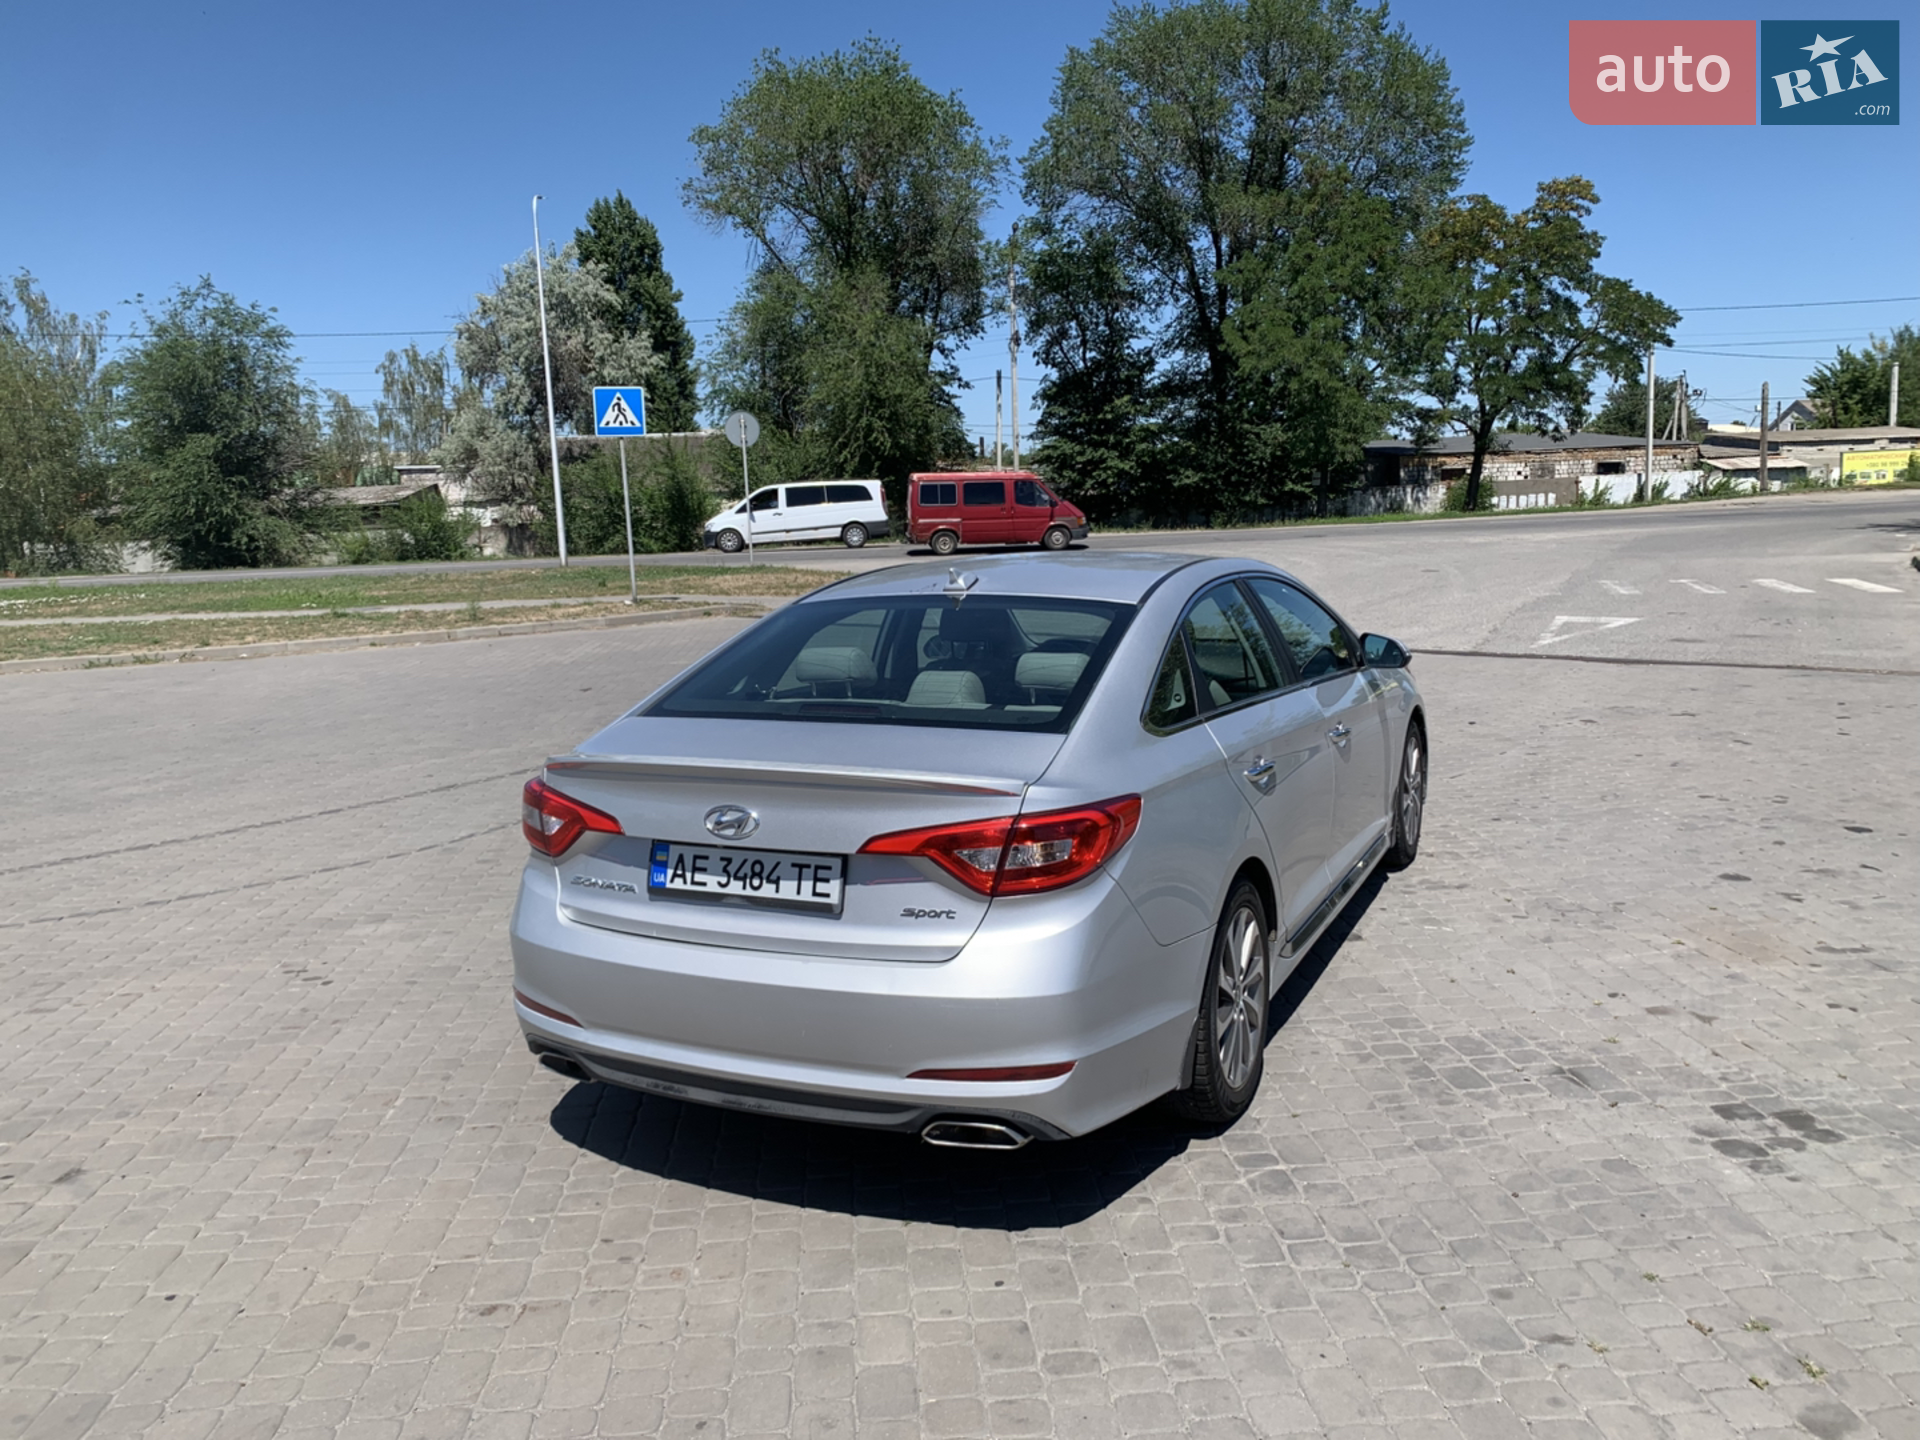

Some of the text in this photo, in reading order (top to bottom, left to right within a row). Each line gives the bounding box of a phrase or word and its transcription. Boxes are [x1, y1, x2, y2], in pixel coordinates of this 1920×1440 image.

[653, 871, 666, 883] UA
[669, 853, 833, 898] AE 3484 TE
[570, 874, 638, 894] SONATA
[900, 907, 957, 920] Sport
